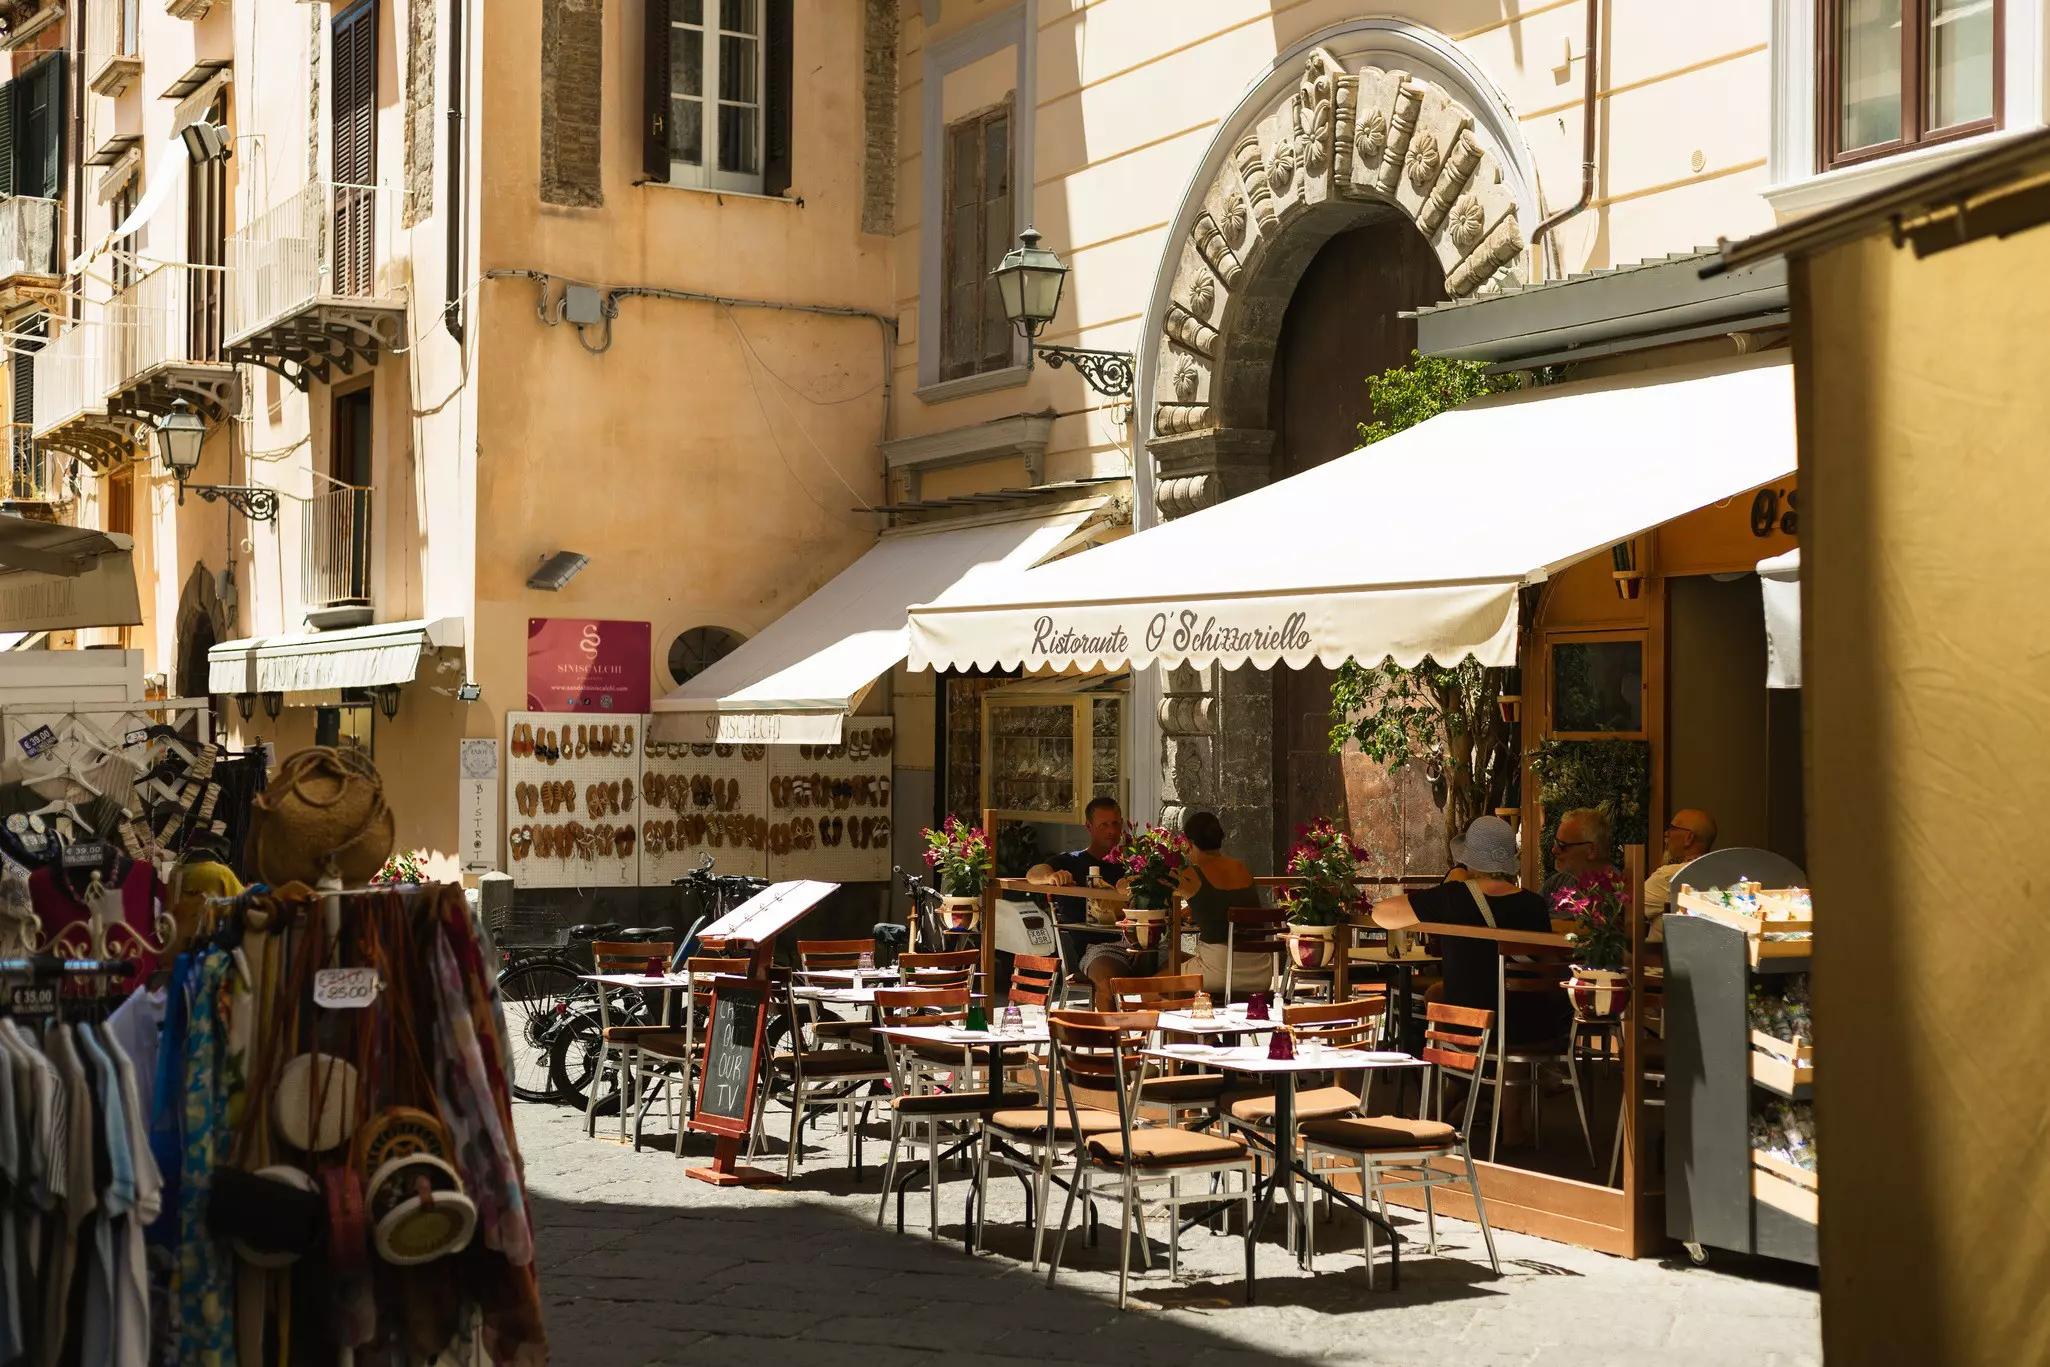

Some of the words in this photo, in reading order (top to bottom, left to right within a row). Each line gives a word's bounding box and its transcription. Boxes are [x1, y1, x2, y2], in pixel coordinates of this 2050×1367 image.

[1031, 614, 1129, 656] Ristorante
[557, 664, 622, 674] SINISCALCHI
[705, 715, 780, 739] SINISCALCHI
[473, 783, 484, 860] BISTROT
[723, 1023, 747, 1051] OUT
[718, 1052, 743, 1081] OUR
[717, 1084, 740, 1112] TV
